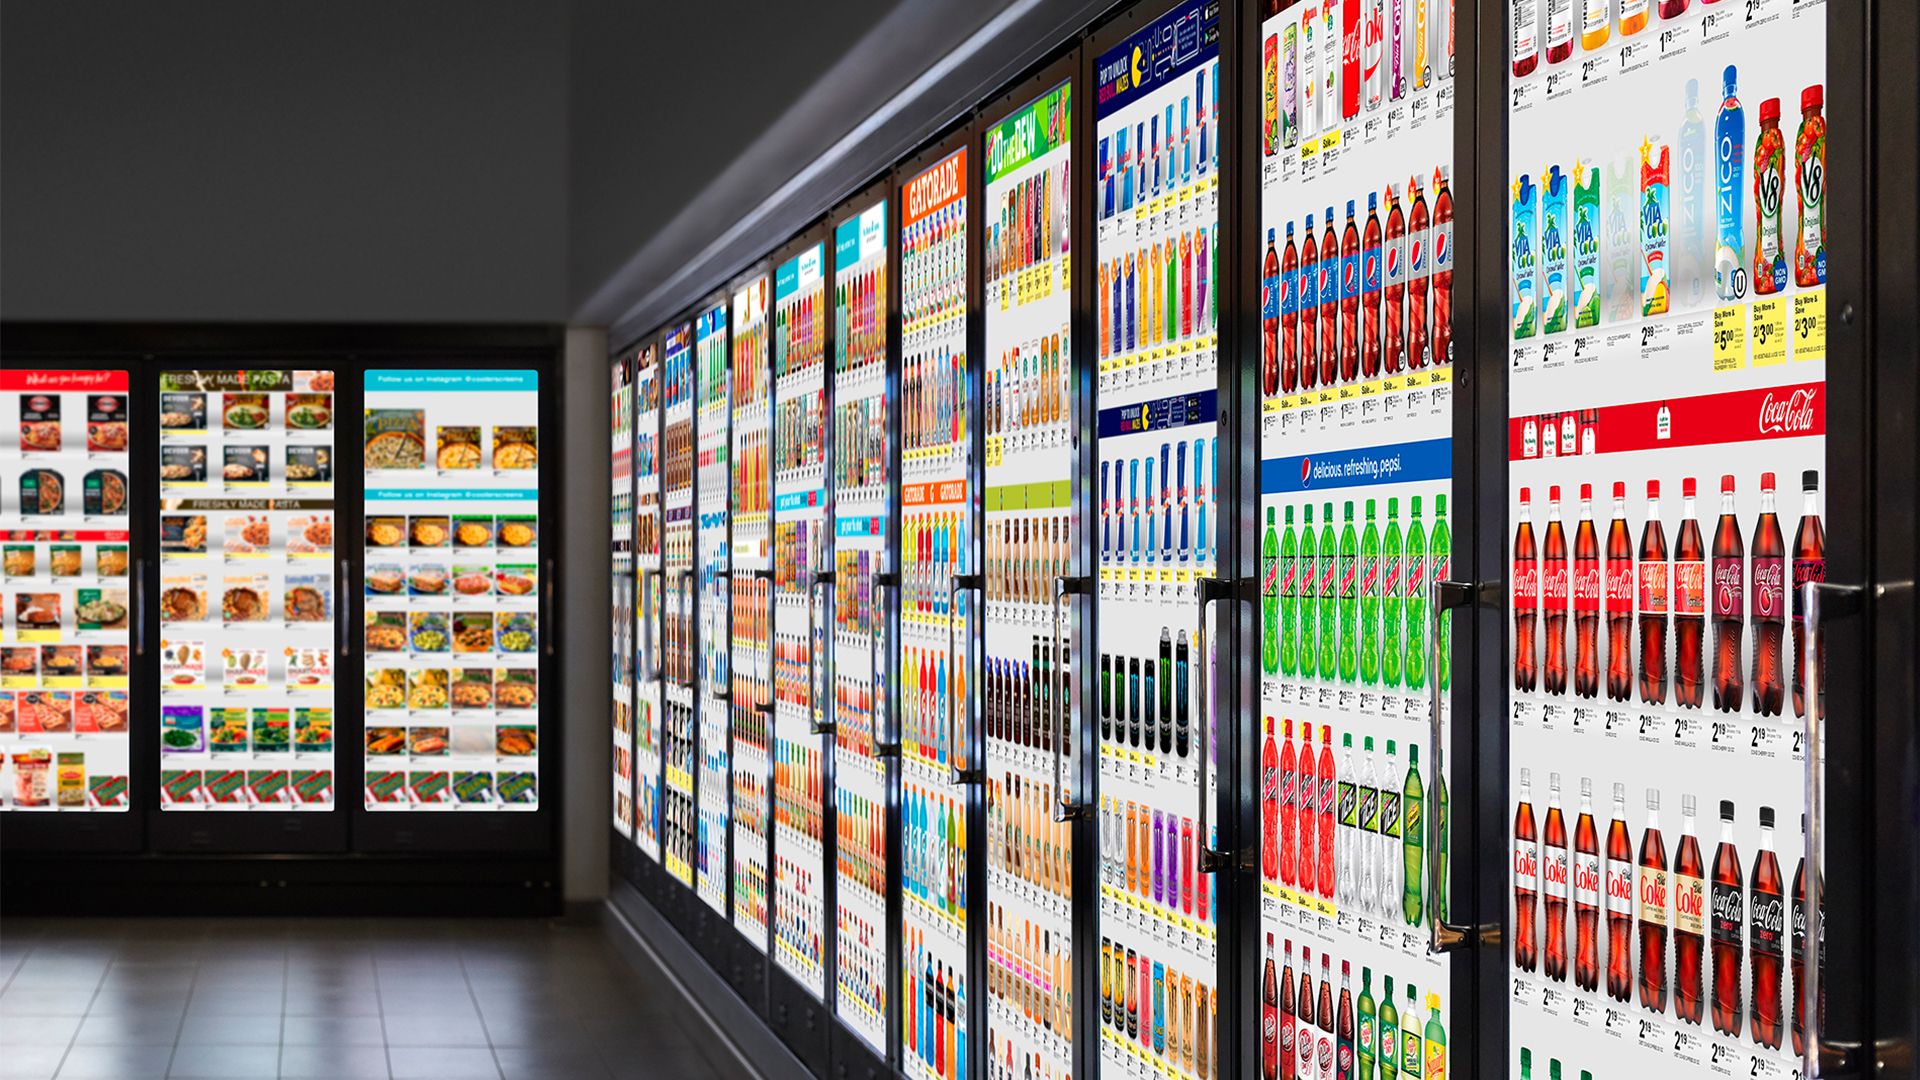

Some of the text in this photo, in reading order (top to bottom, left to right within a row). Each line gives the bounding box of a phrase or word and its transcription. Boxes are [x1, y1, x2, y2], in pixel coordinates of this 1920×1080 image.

[1015, 109, 1036, 161] DEW
[1720, 136, 1733, 214] ZICO
[1801, 151, 1823, 202] V8
[909, 156, 959, 218] GATORADE
[1760, 163, 1780, 213] V8
[1642, 202, 1663, 226] VITA
[1544, 228, 1562, 249] VITA
[1575, 221, 1594, 243] VITA
[1514, 235, 1531, 257] VITA
[1775, 268, 1786, 276] NON
[1817, 260, 1826, 269] NO
[1775, 275, 1786, 284] GMO
[1753, 305, 1761, 314] Buy
[1761, 303, 1771, 311] More
[1795, 298, 1803, 307] Buy
[1803, 296, 1814, 304] More
[1795, 307, 1805, 315] Save
[1714, 312, 1722, 320] Buy
[1722, 310, 1731, 318] More
[1714, 320, 1724, 328] Save
[1759, 388, 1817, 434] Coca-Cola
[904, 485, 925, 503] GATORADE
[940, 482, 963, 501] GATORADE
[1514, 849, 1537, 878] Coke
[1543, 856, 1566, 885] Coke
[1574, 863, 1598, 892] Coke
[1605, 870, 1632, 901] Coke
[1639, 875, 1666, 908] Coke
[1675, 882, 1703, 917] Coke
[1720, 920, 1733, 931] zero
[1760, 930, 1773, 941] zero
